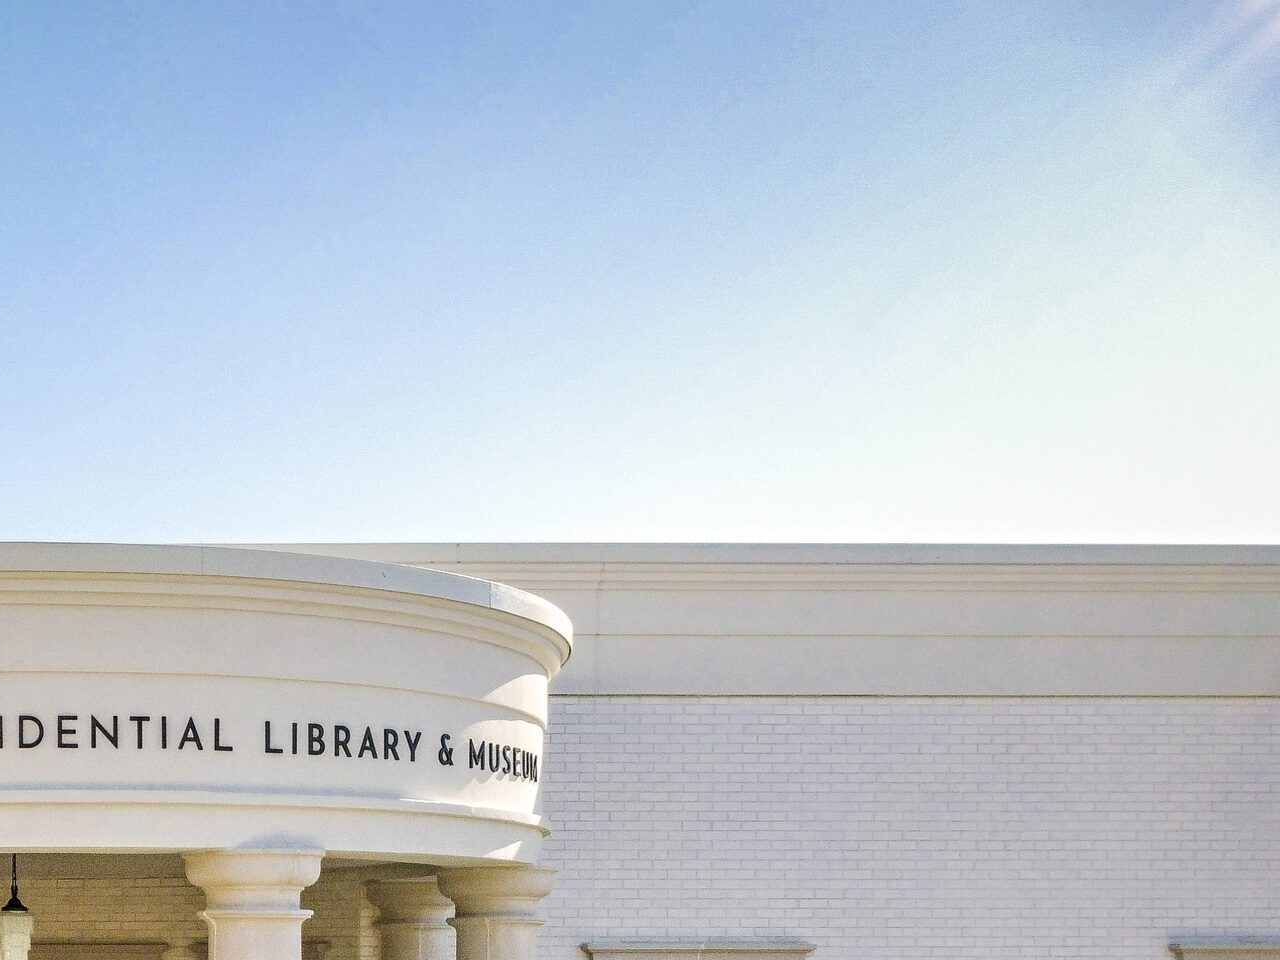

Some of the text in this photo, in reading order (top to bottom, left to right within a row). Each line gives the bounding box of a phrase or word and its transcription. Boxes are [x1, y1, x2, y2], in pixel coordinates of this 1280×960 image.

[264, 720, 422, 762] LIBRARY
[437, 733, 454, 767] &
[468, 738, 538, 783] MUSEUM
